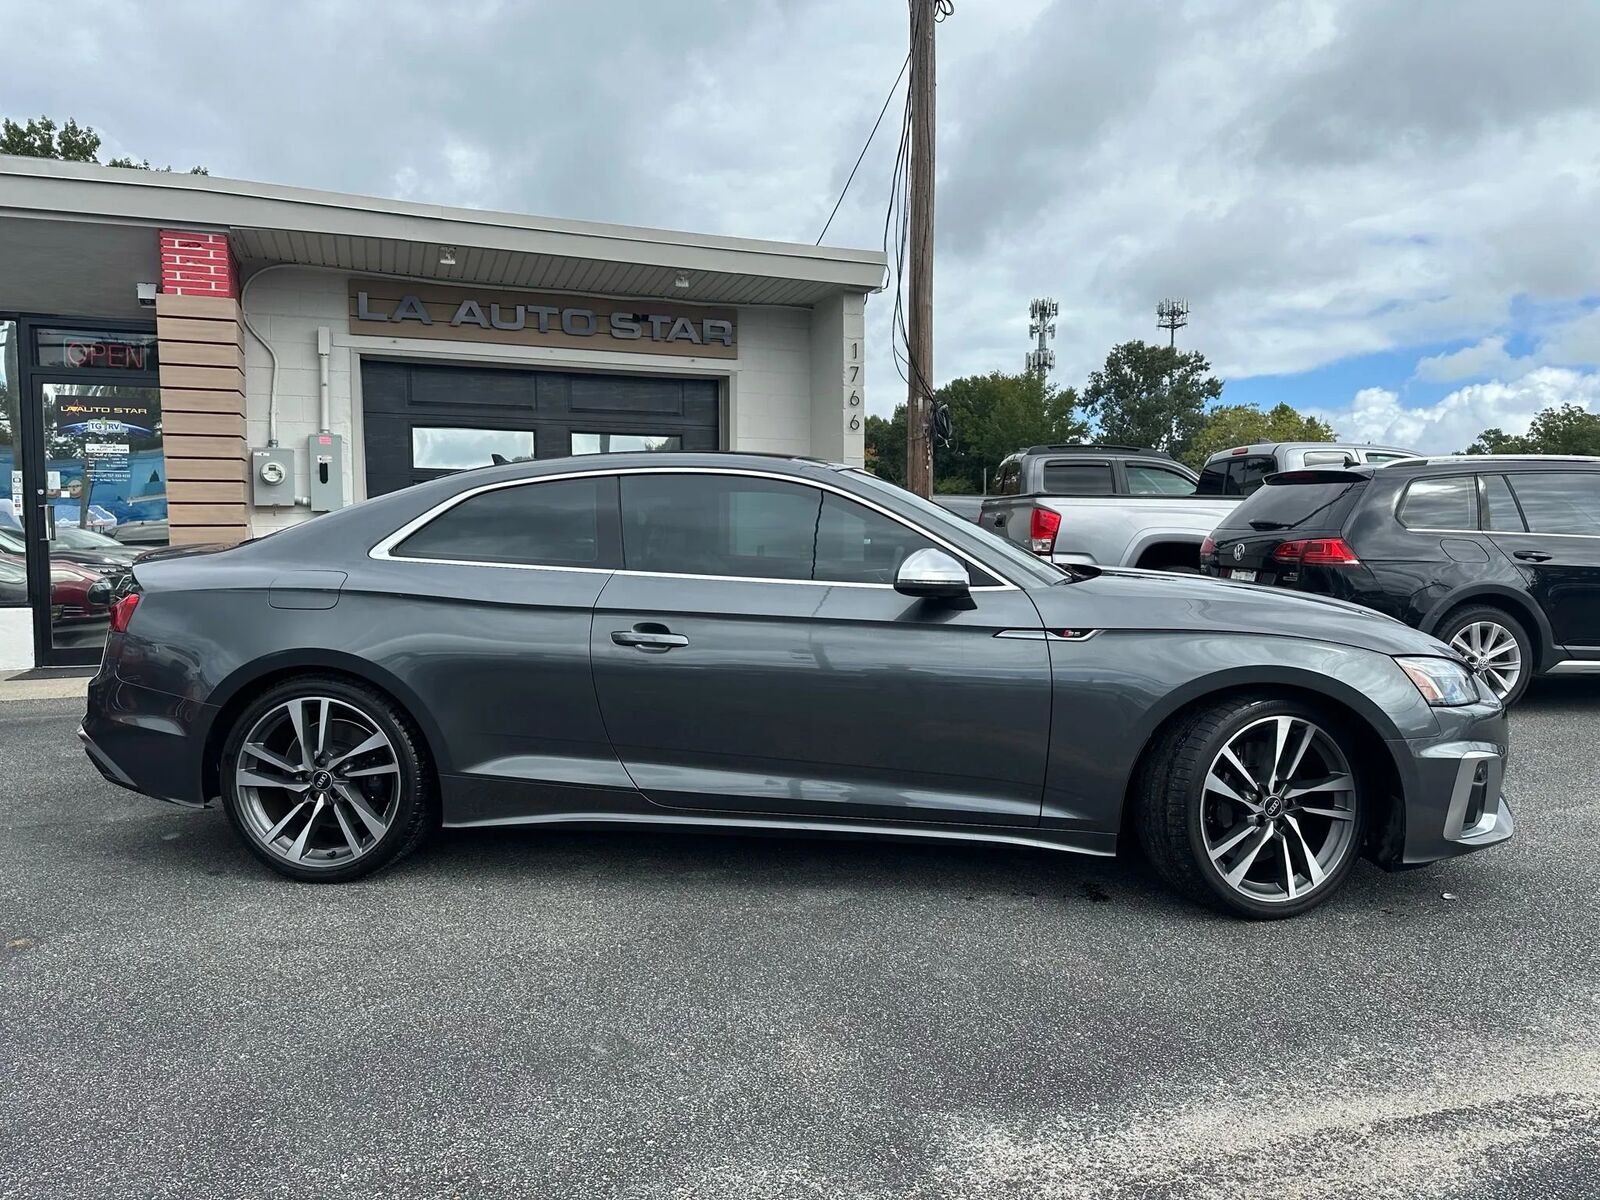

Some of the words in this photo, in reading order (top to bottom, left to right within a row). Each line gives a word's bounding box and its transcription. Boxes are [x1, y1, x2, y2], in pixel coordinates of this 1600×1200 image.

[358, 291, 433, 326] LA
[450, 300, 599, 337] AUTO
[609, 312, 733, 346] STAR
[67, 342, 143, 368] OPEN
[849, 342, 860, 431] 1766
[113, 407, 148, 415] STAR
